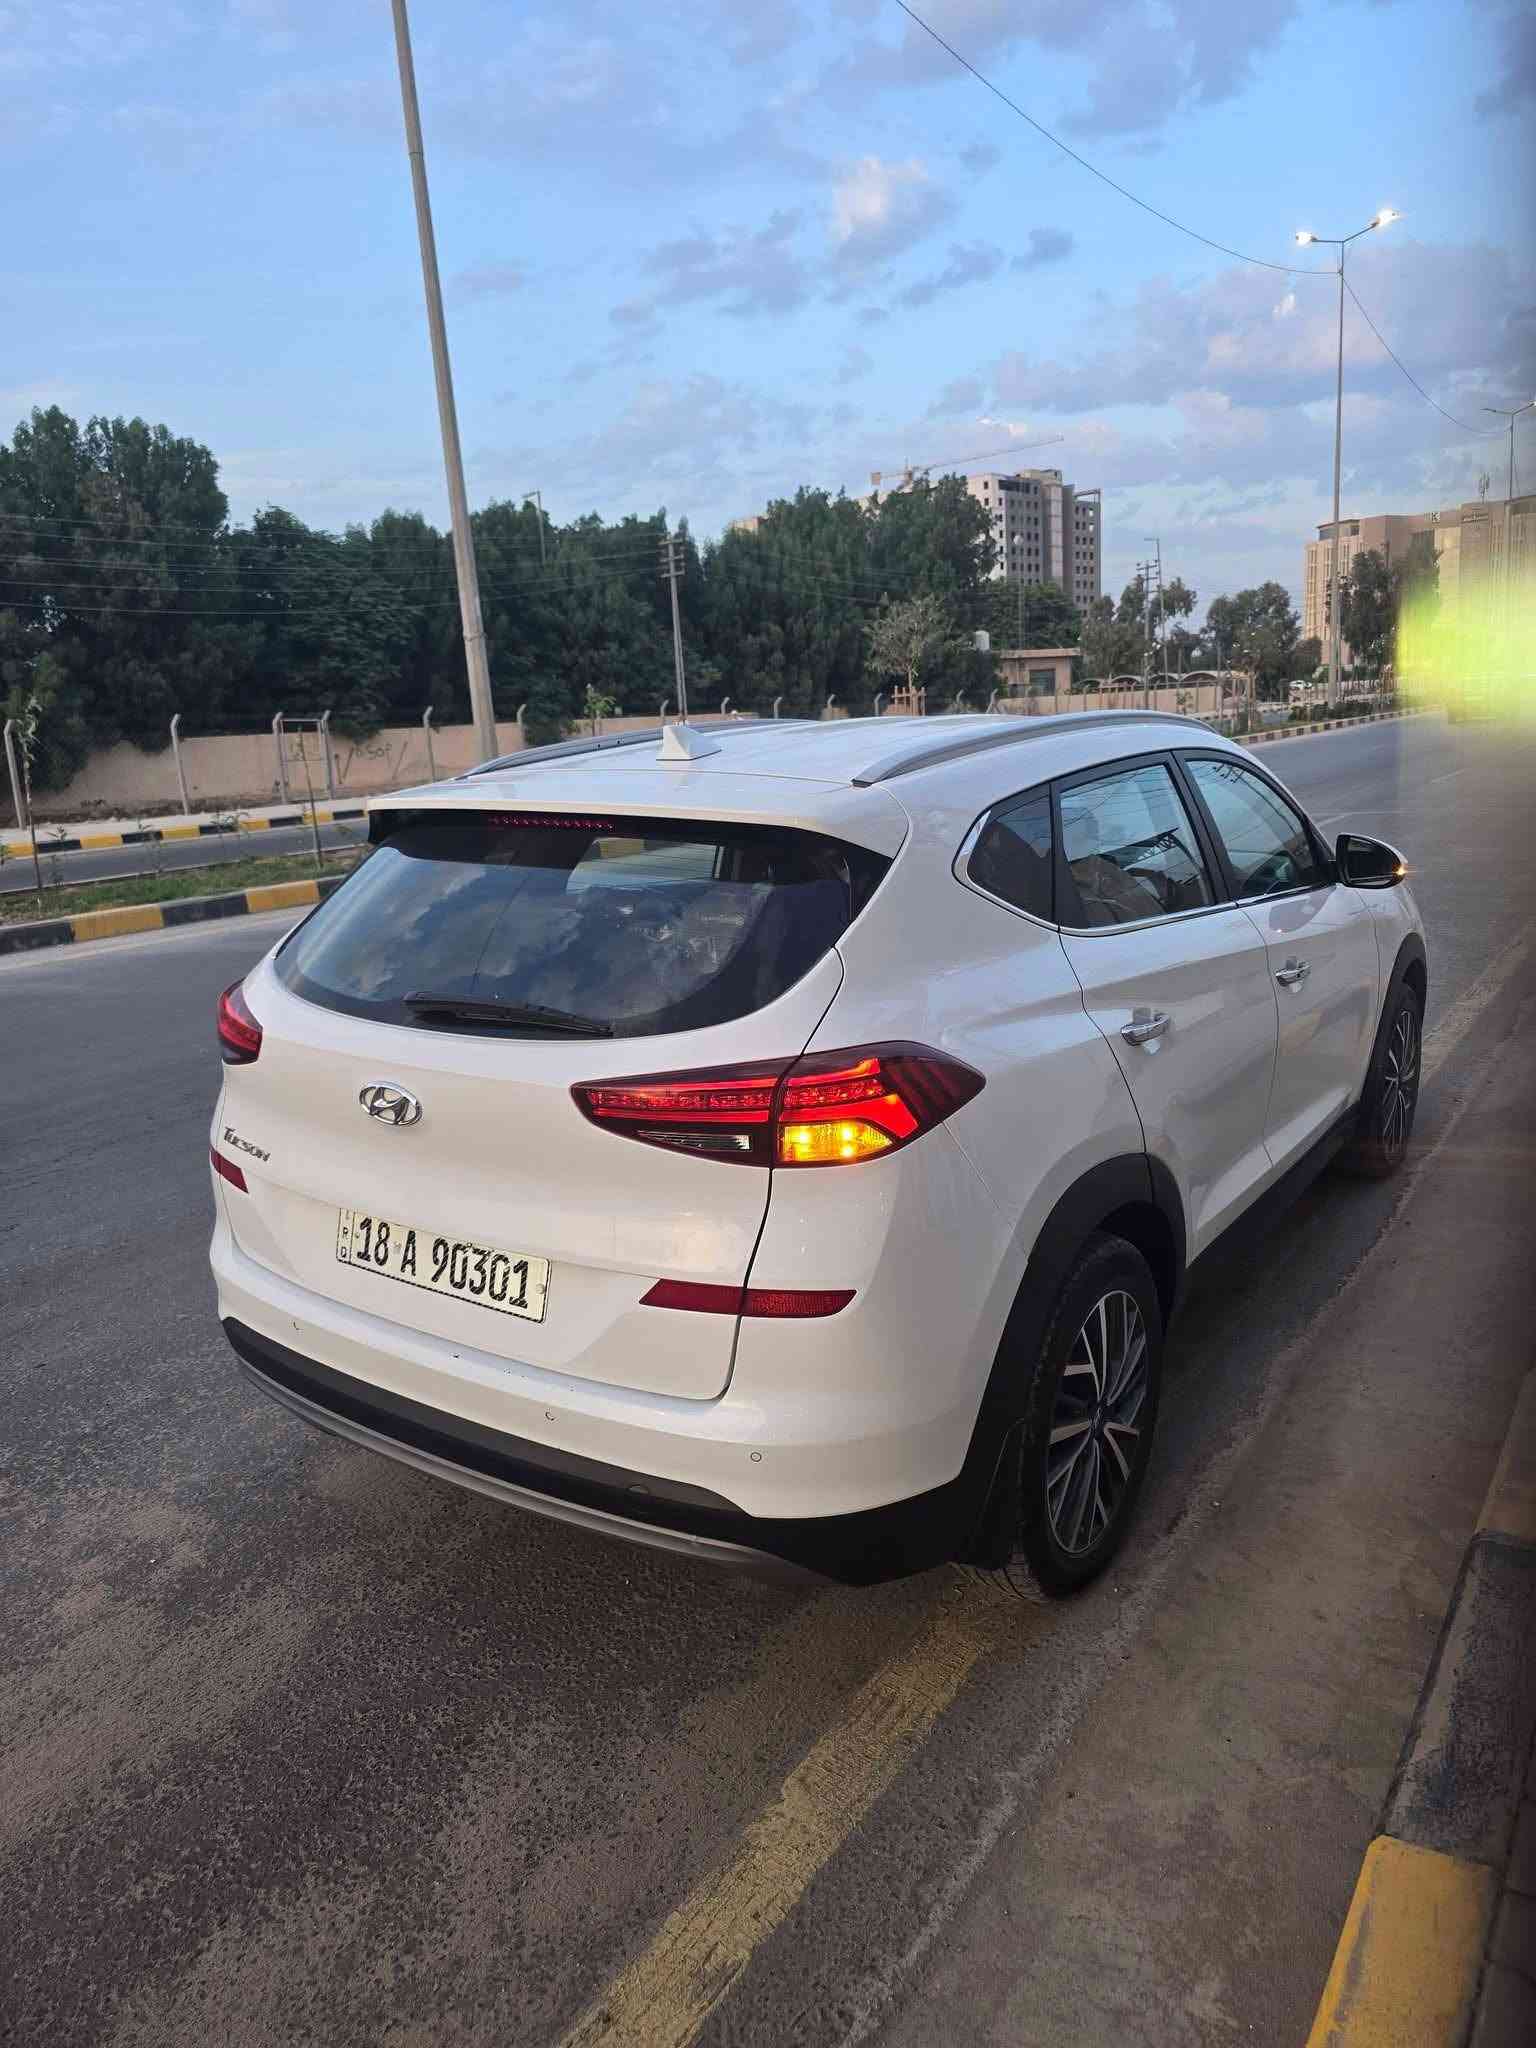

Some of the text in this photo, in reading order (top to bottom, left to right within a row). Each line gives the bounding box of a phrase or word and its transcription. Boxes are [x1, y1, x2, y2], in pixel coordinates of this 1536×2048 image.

[357, 1217, 529, 1309] 18 A 90301
